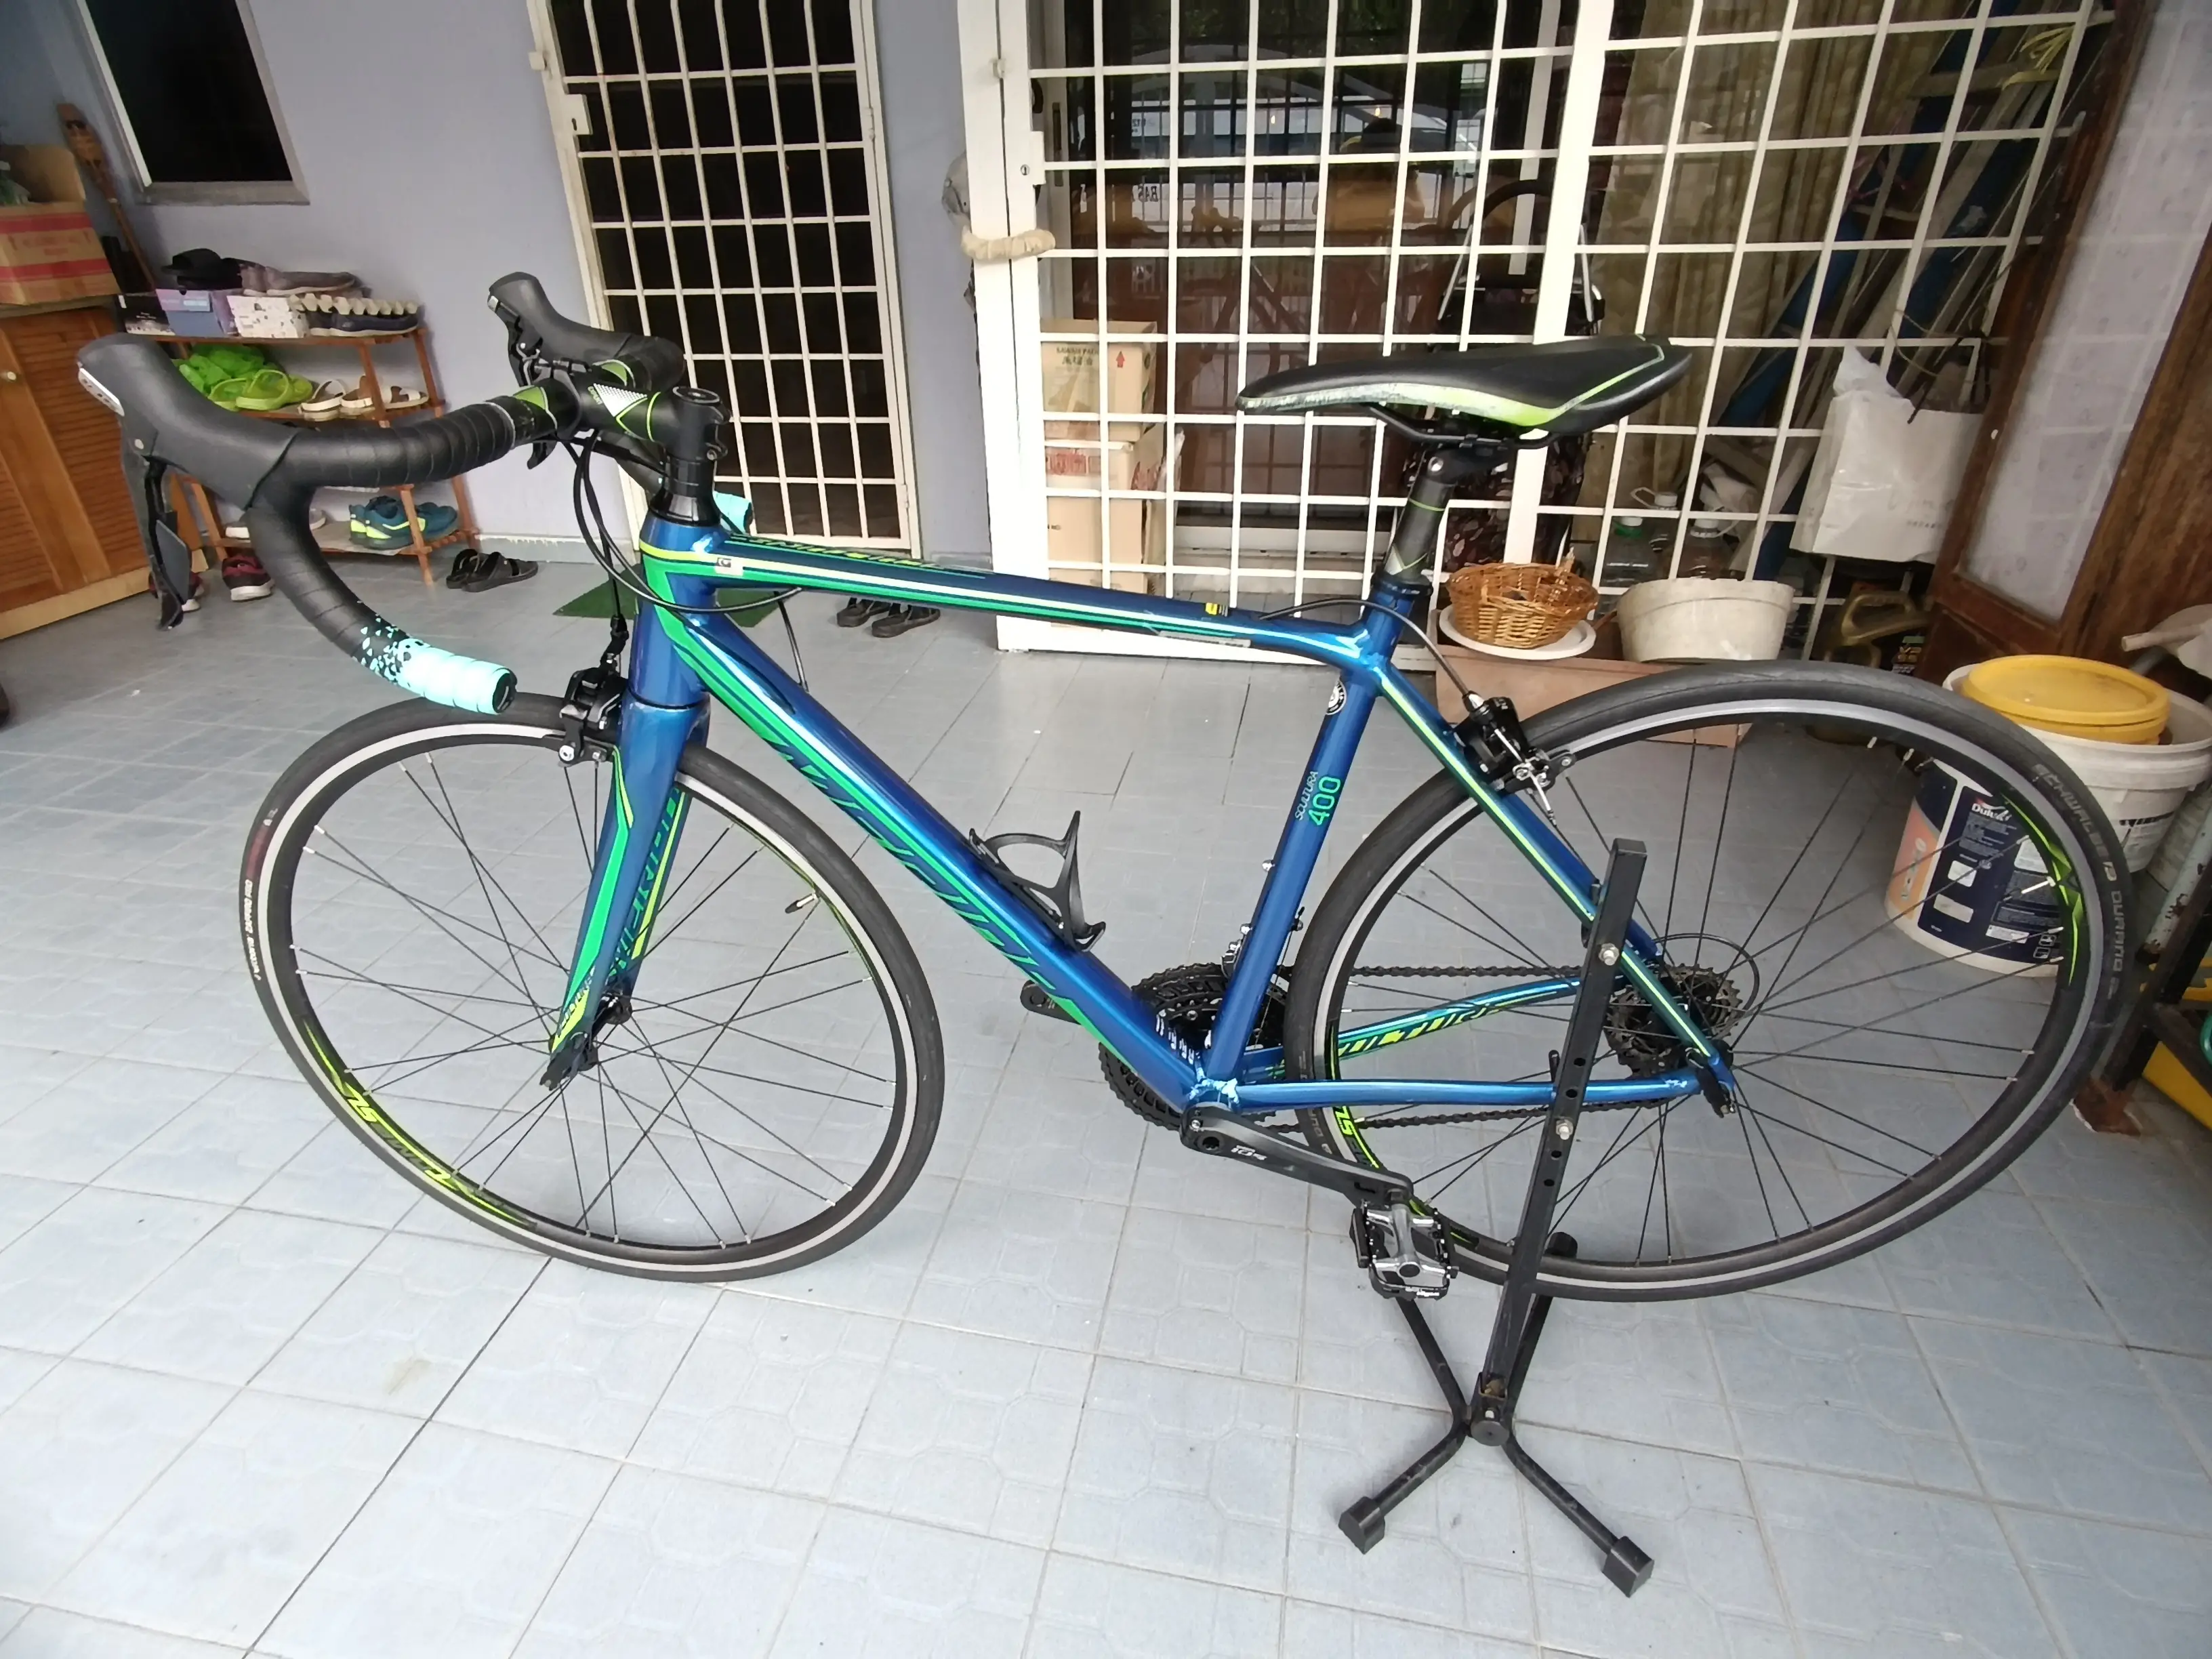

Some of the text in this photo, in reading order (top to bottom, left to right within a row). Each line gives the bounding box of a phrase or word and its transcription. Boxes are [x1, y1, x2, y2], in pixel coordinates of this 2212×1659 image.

[1294, 771, 1318, 821] SCULTURA
[1308, 776, 1341, 825] 400
[1971, 803, 2012, 821] Dulux
